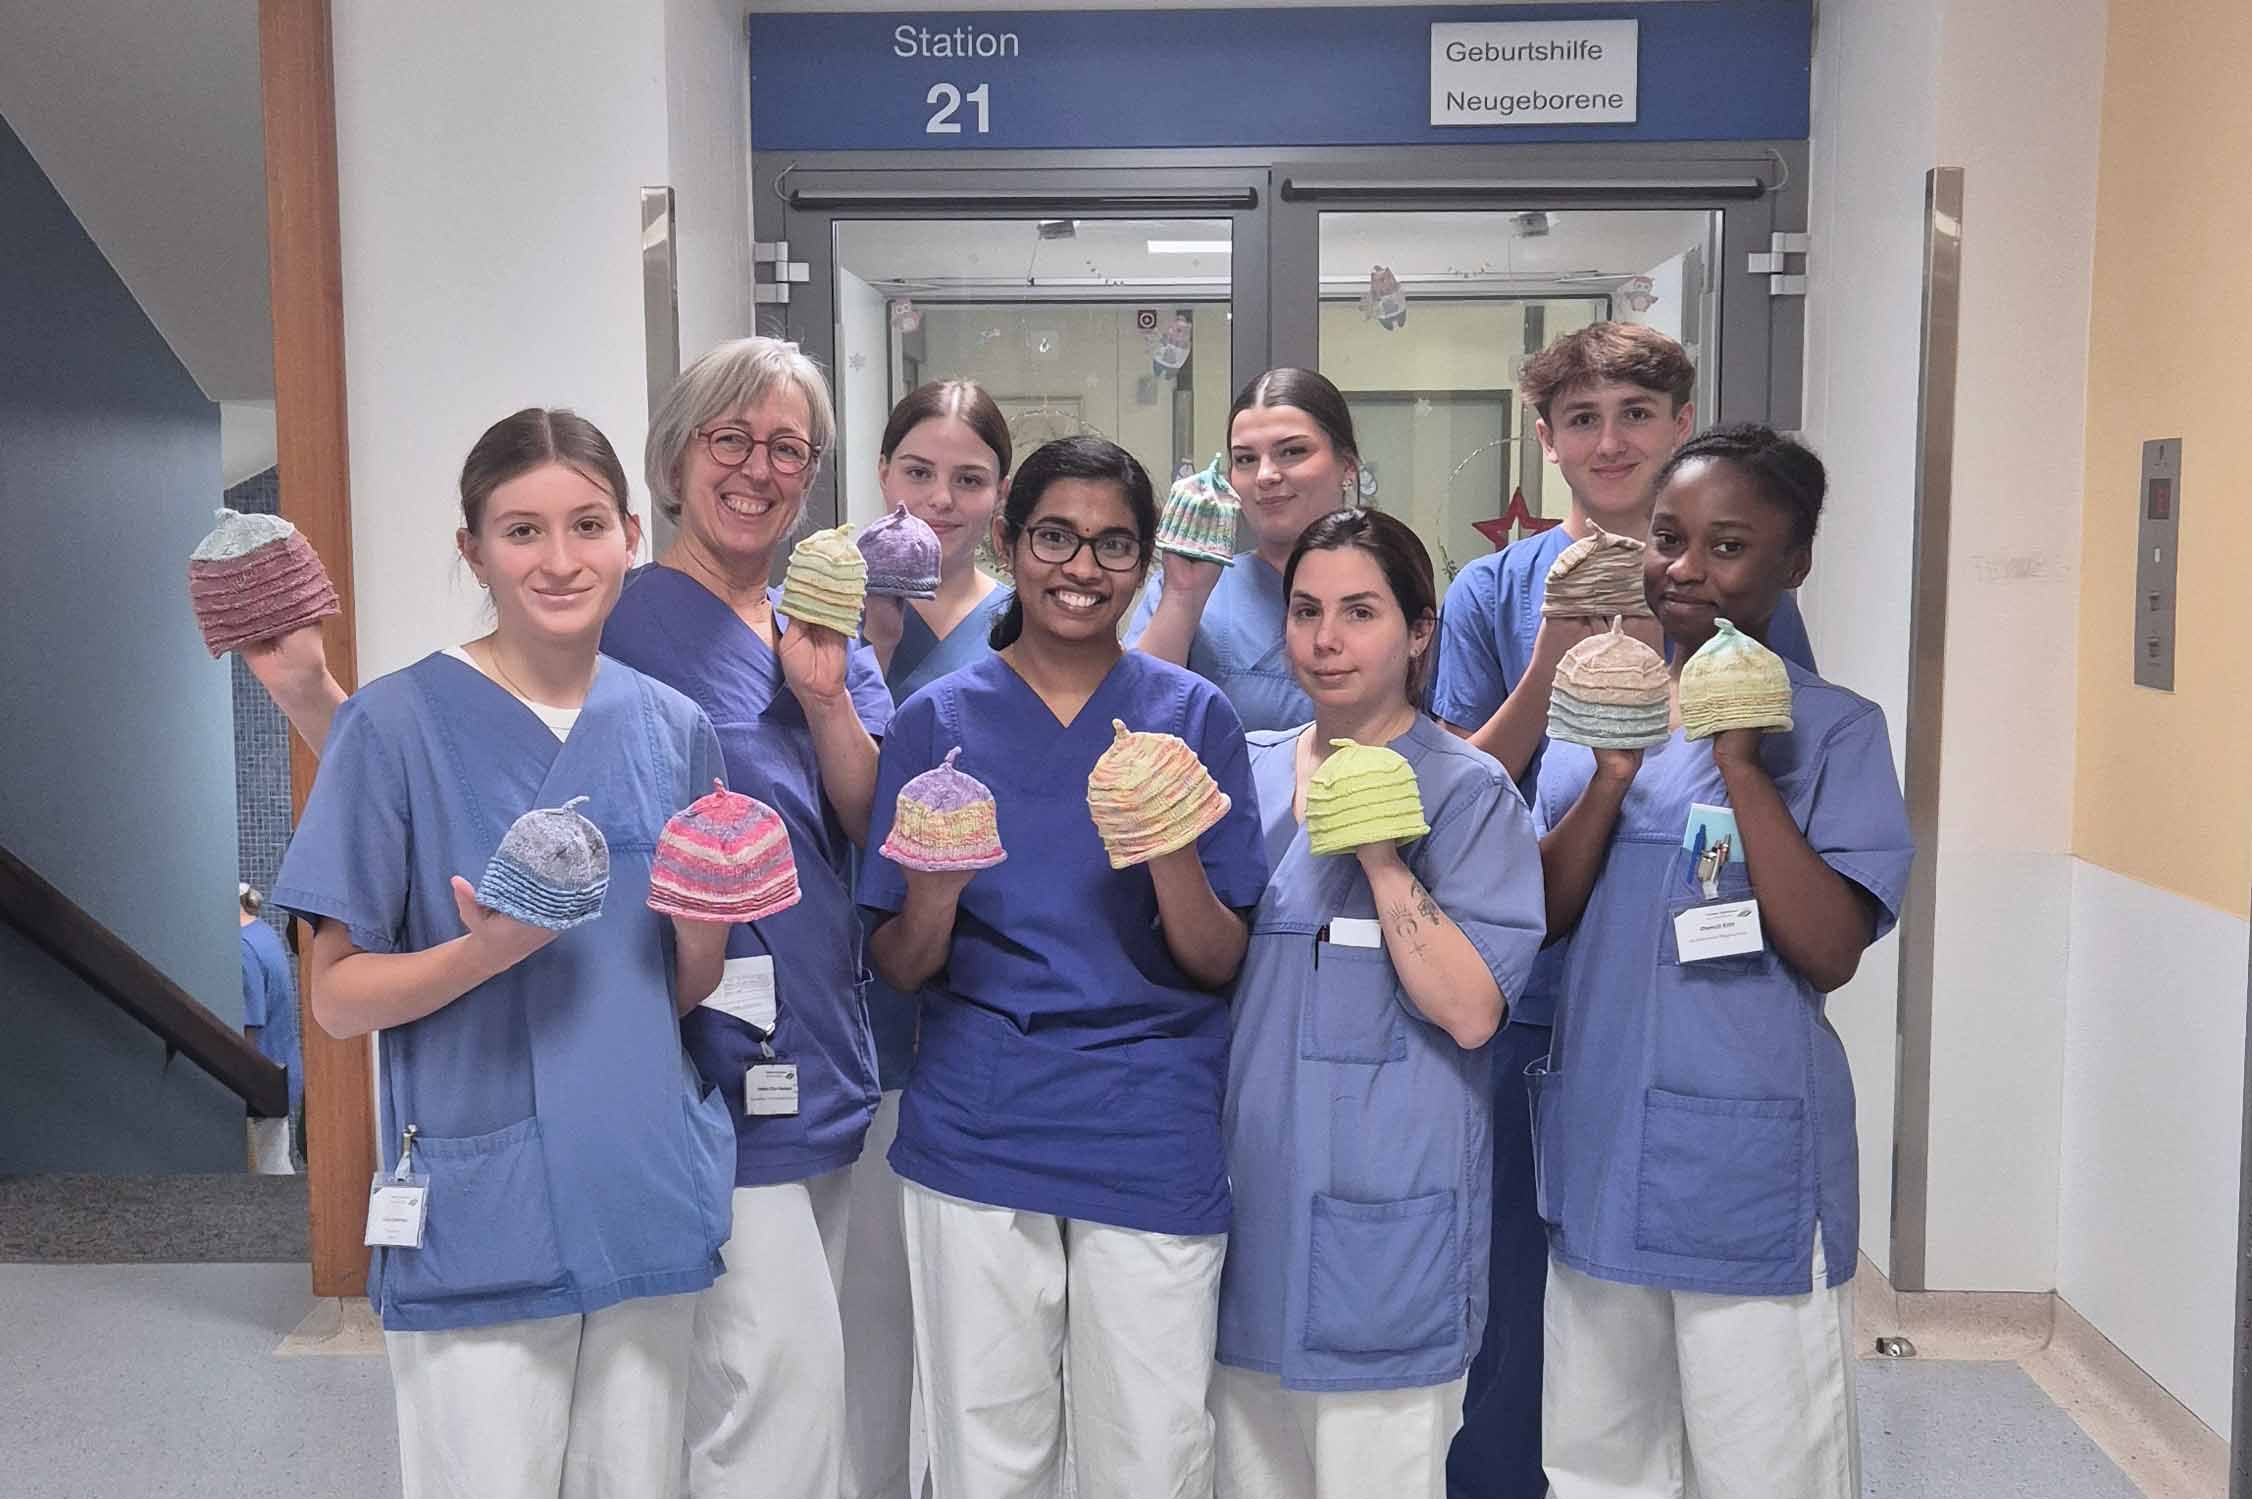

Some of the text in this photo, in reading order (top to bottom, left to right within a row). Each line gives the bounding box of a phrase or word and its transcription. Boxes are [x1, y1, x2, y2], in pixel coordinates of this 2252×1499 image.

[894, 25, 1019, 57] Station
[1446, 40, 1603, 62] Geburtshilfe
[926, 83, 990, 133] 21
[1447, 90, 1624, 115] Neugeborene
